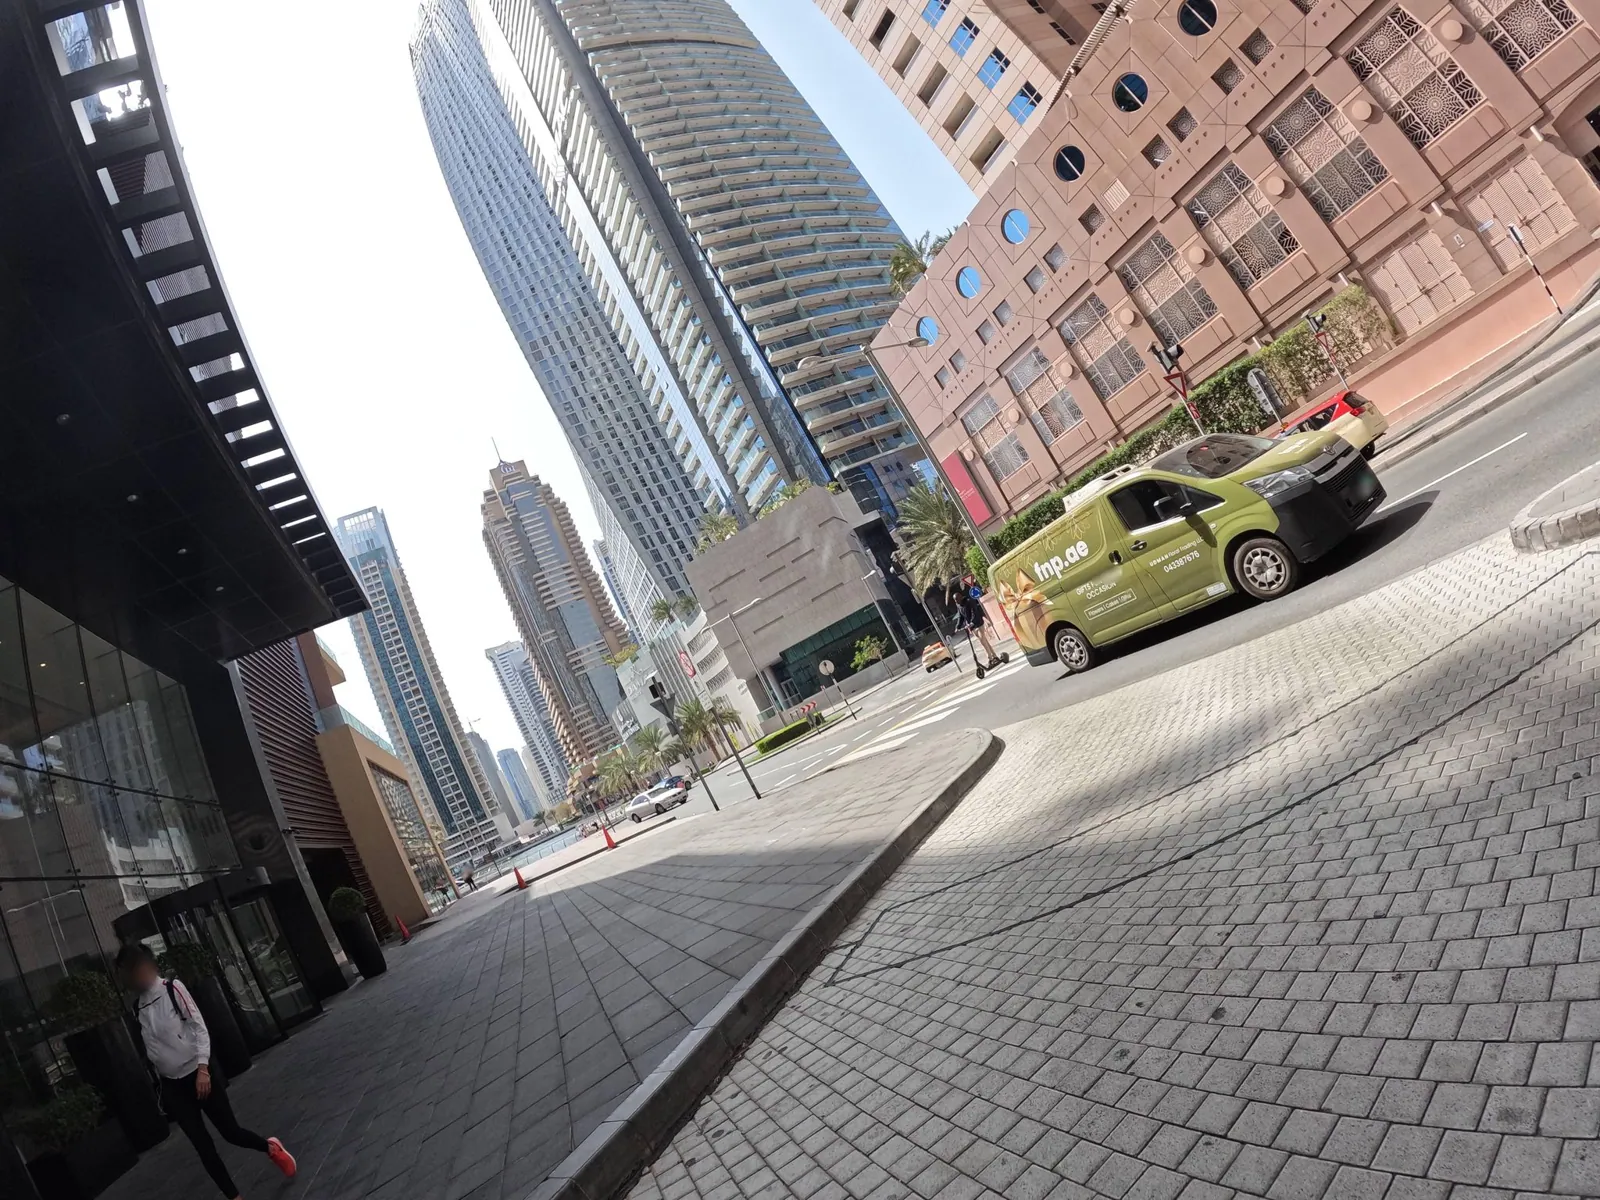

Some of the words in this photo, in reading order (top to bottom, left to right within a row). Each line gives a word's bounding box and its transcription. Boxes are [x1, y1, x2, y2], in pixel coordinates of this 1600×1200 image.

[1034, 541, 1089, 581] fnp.ae
[1163, 550, 1200, 573] 043387676
[1076, 582, 1092, 595] GIFTS
[1086, 582, 1117, 599] OCCASION
